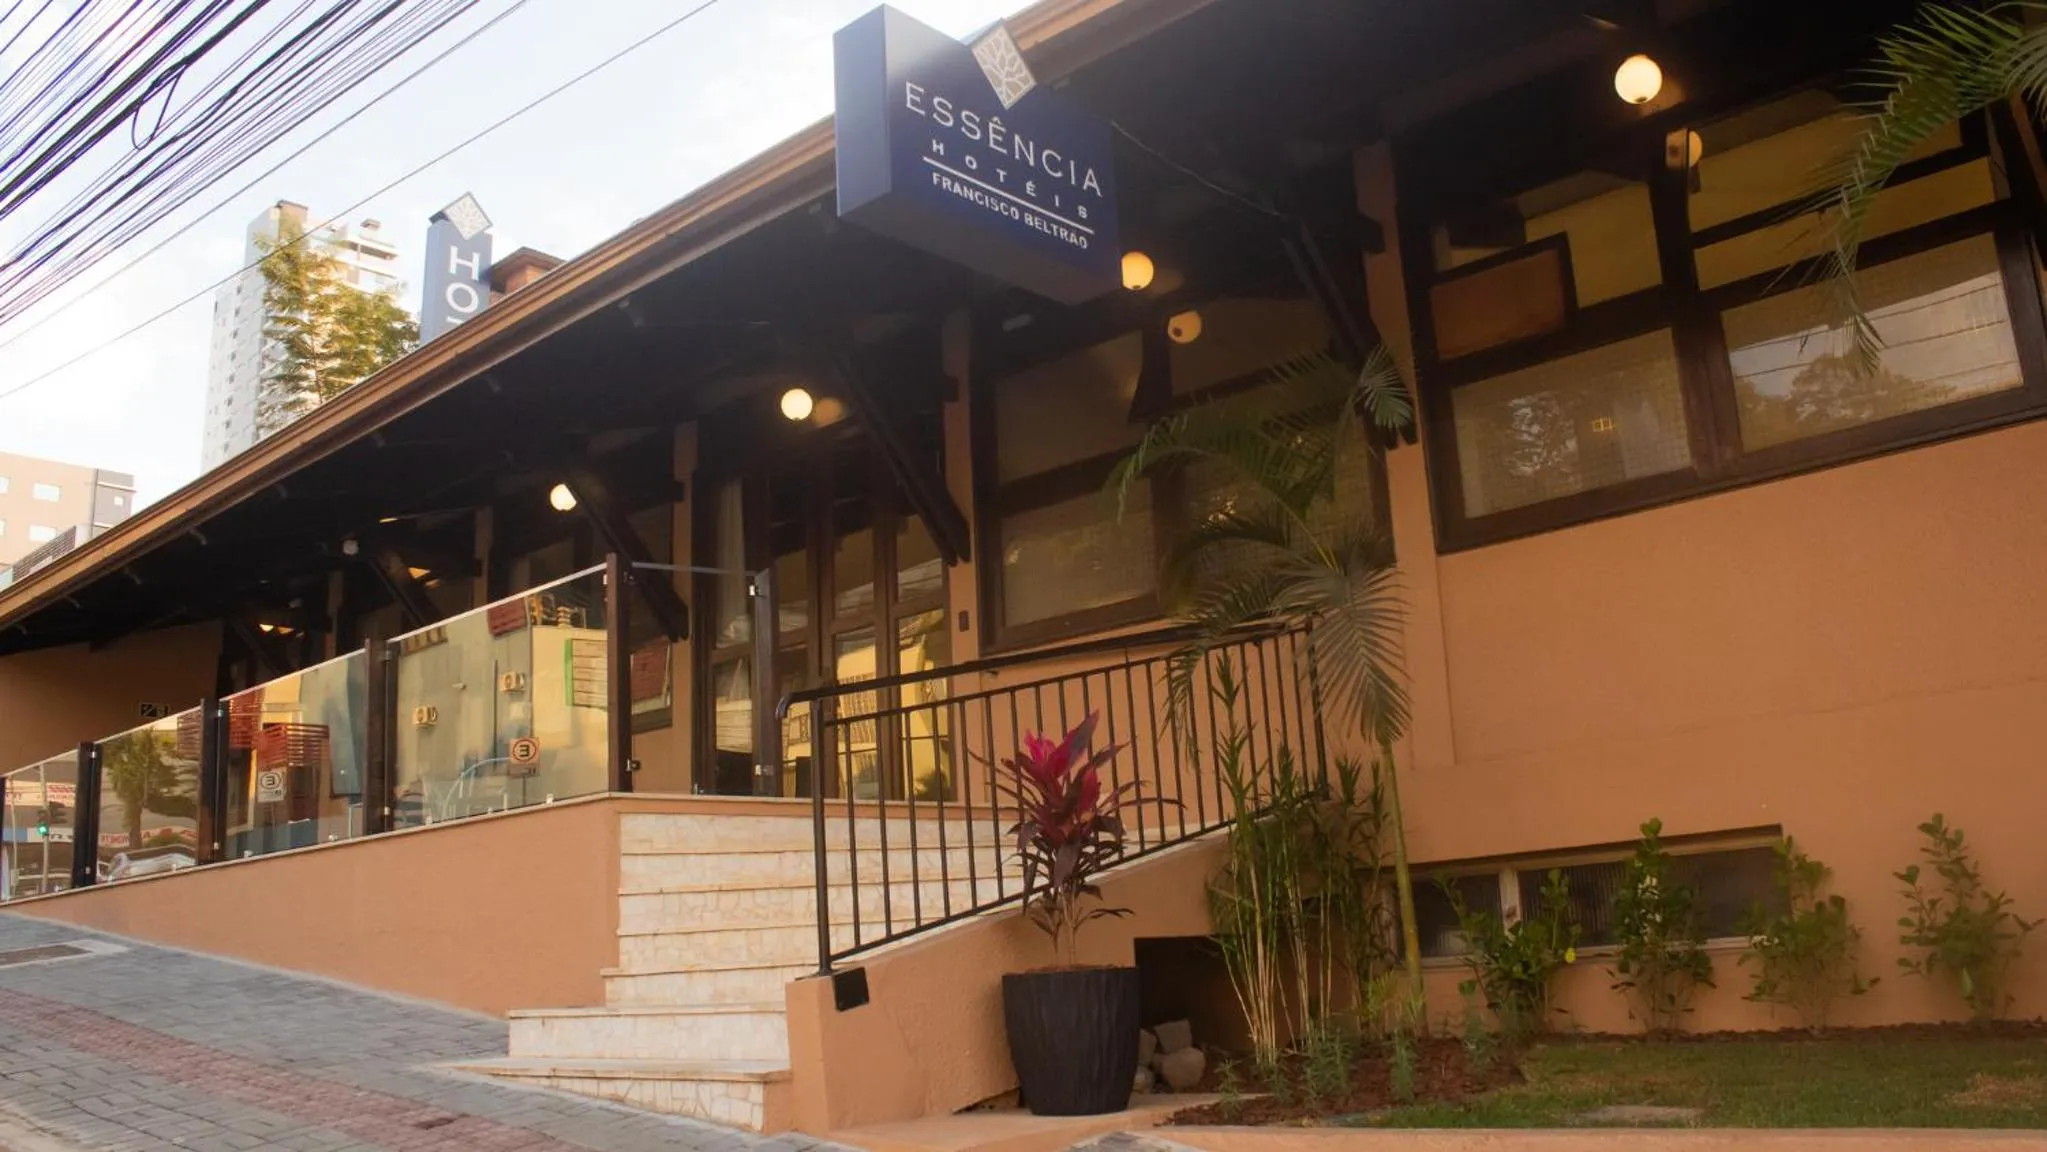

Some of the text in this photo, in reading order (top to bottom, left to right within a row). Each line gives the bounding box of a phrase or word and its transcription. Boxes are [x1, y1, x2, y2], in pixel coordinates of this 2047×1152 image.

[905, 81, 1103, 198] ESSÊNCIA
[932, 139, 1088, 219] HOTÉIS
[932, 172, 1019, 220] FRANCISCO
[445, 245, 480, 325] HO
